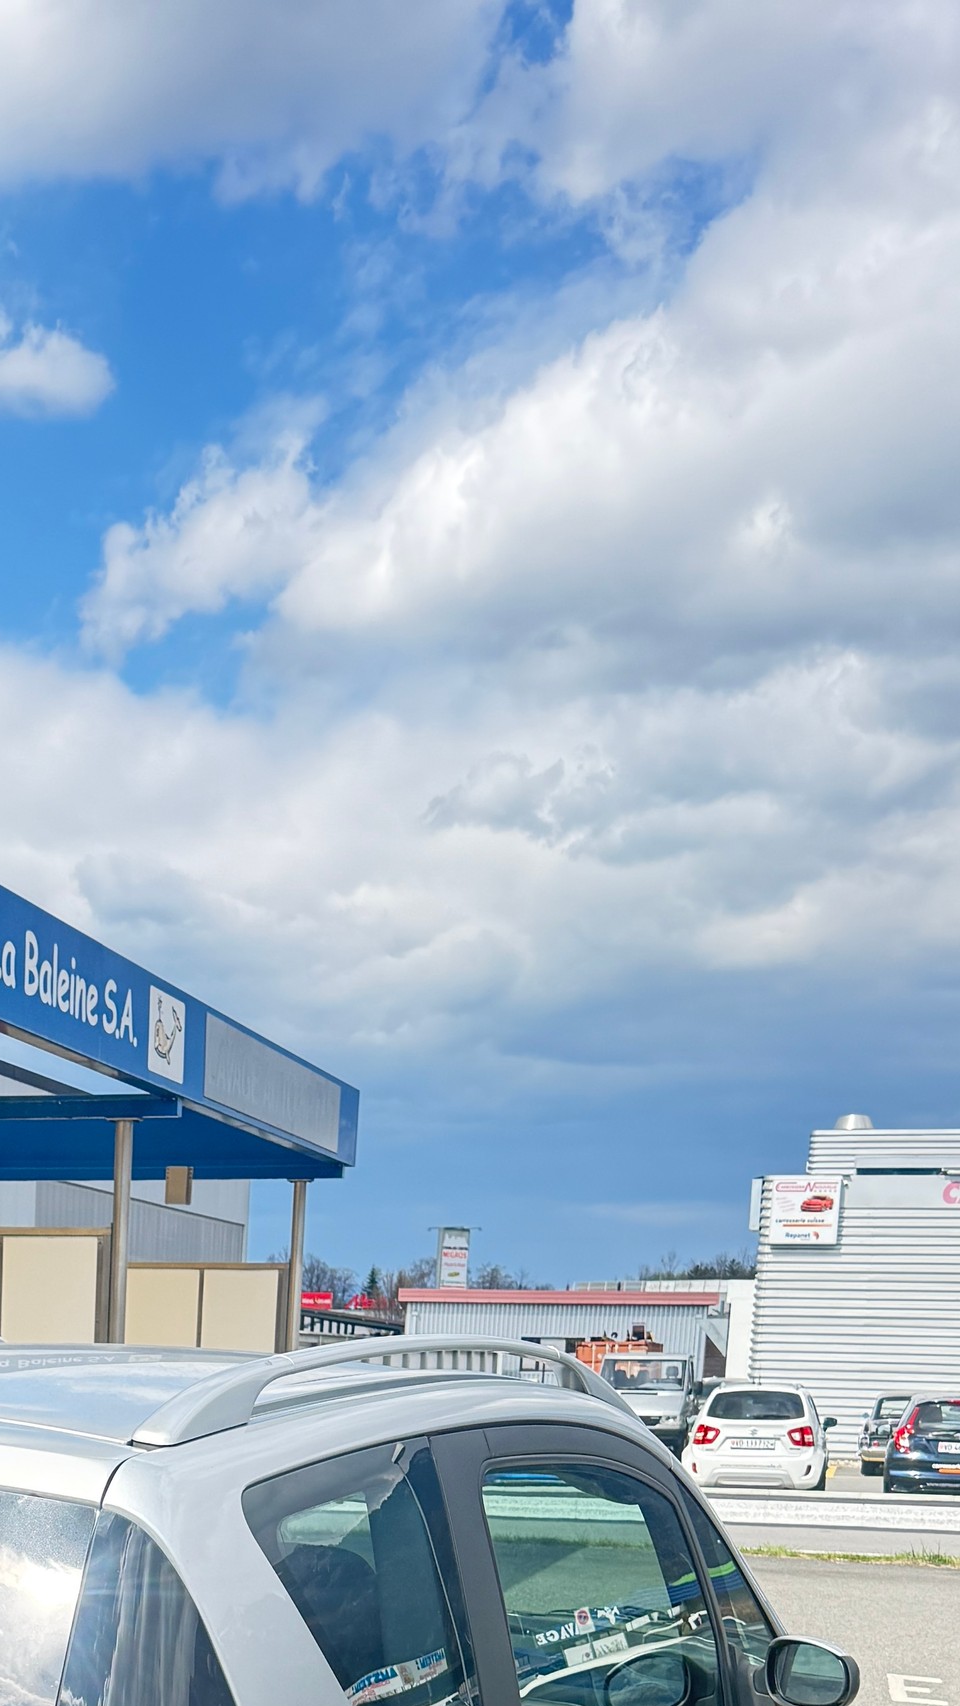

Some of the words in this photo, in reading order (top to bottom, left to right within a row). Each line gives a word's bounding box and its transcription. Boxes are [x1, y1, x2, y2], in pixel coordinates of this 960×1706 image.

[24, 930, 98, 1026] Baleine
[103, 979, 138, 1048] S.A.
[943, 1181, 960, 1204] C
